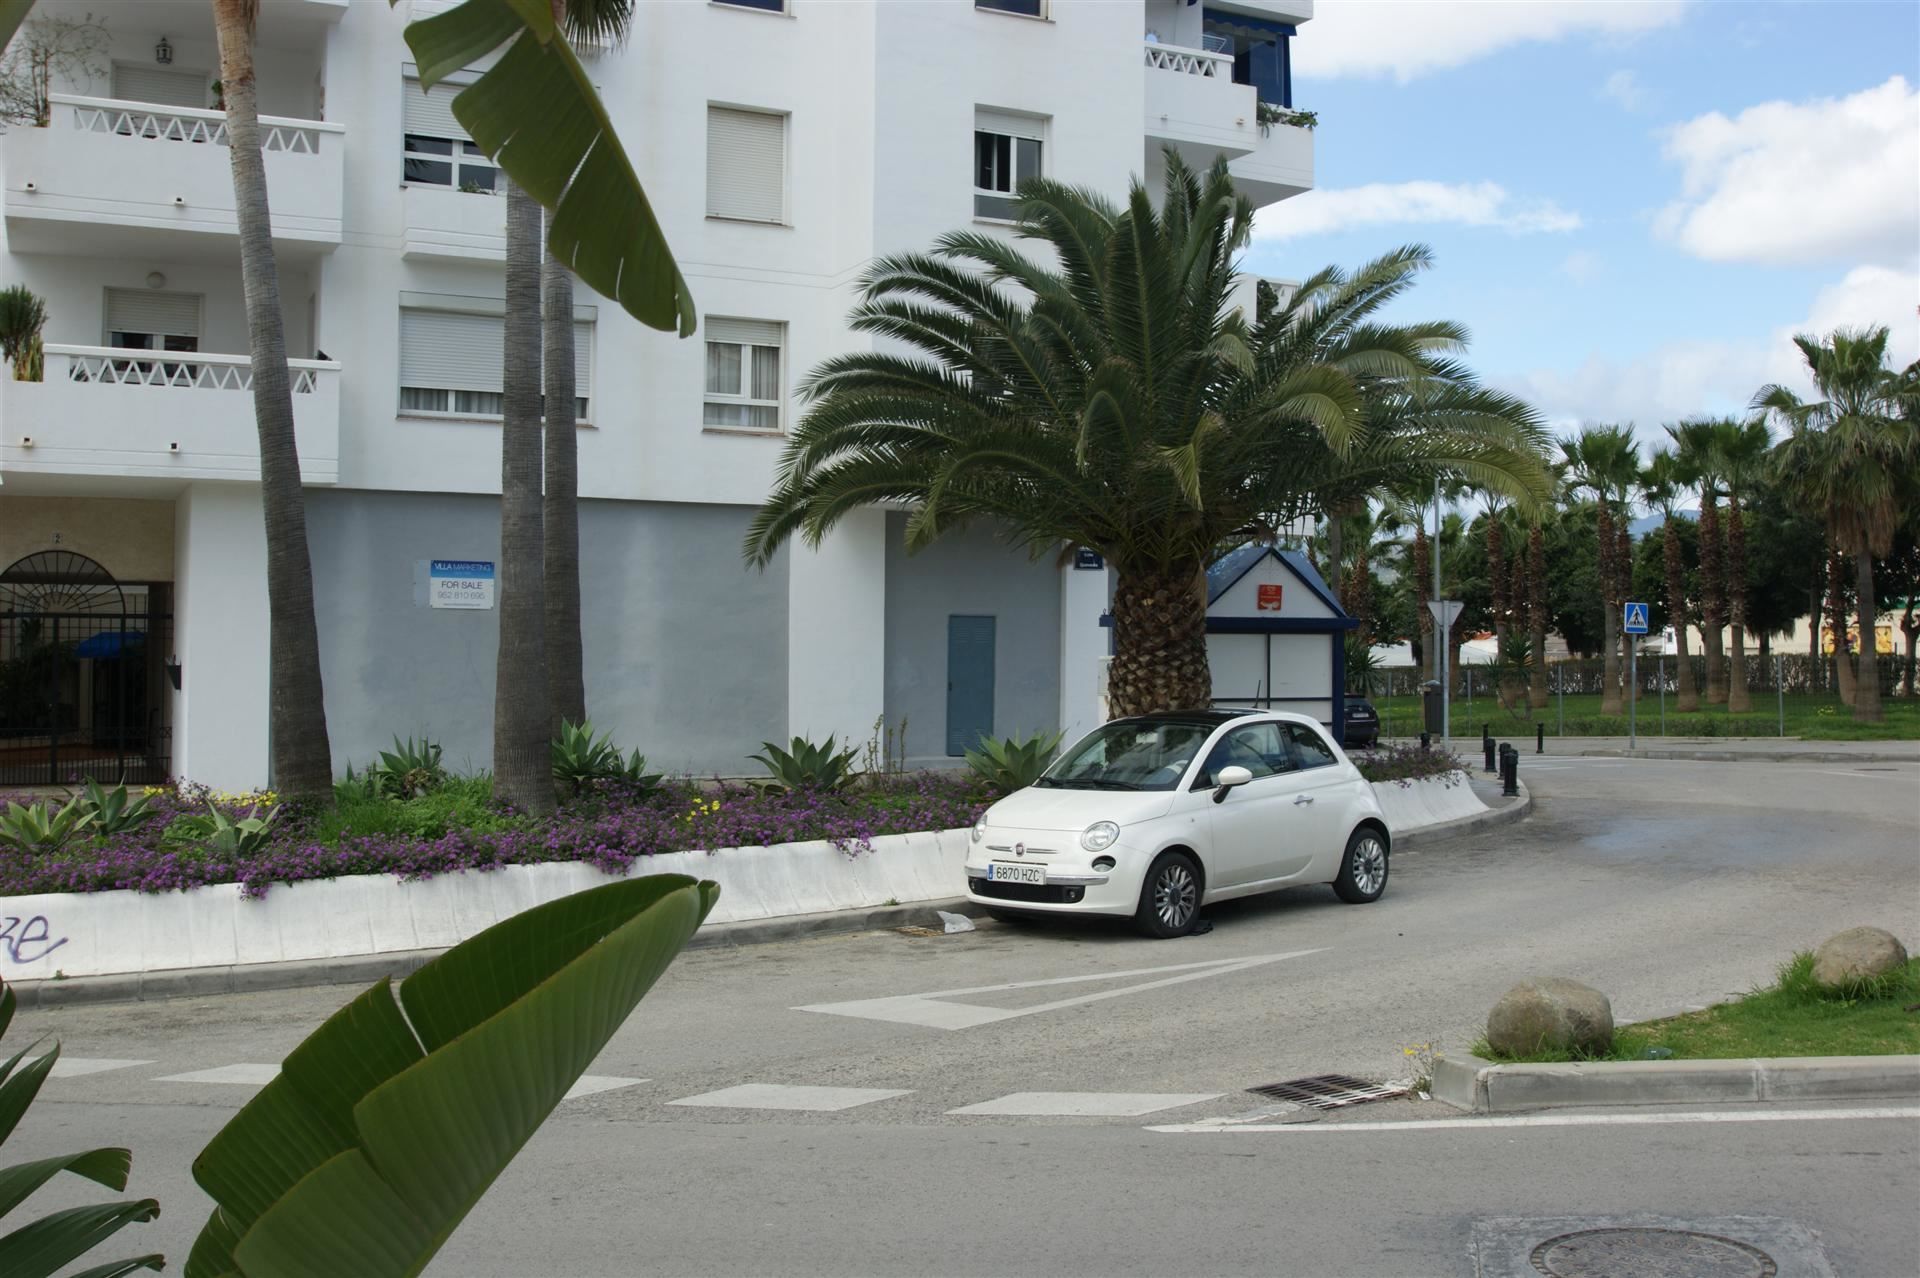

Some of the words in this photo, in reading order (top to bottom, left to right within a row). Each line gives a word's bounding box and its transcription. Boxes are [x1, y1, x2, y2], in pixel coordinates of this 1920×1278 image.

[434, 562, 452, 570] VILLA
[453, 563, 491, 571] MARKETING
[441, 581, 459, 589] FOR
[461, 581, 483, 590] SALE
[454, 591, 469, 600] 810
[996, 866, 1020, 880] 6870
[1022, 868, 1040, 882] HZC
